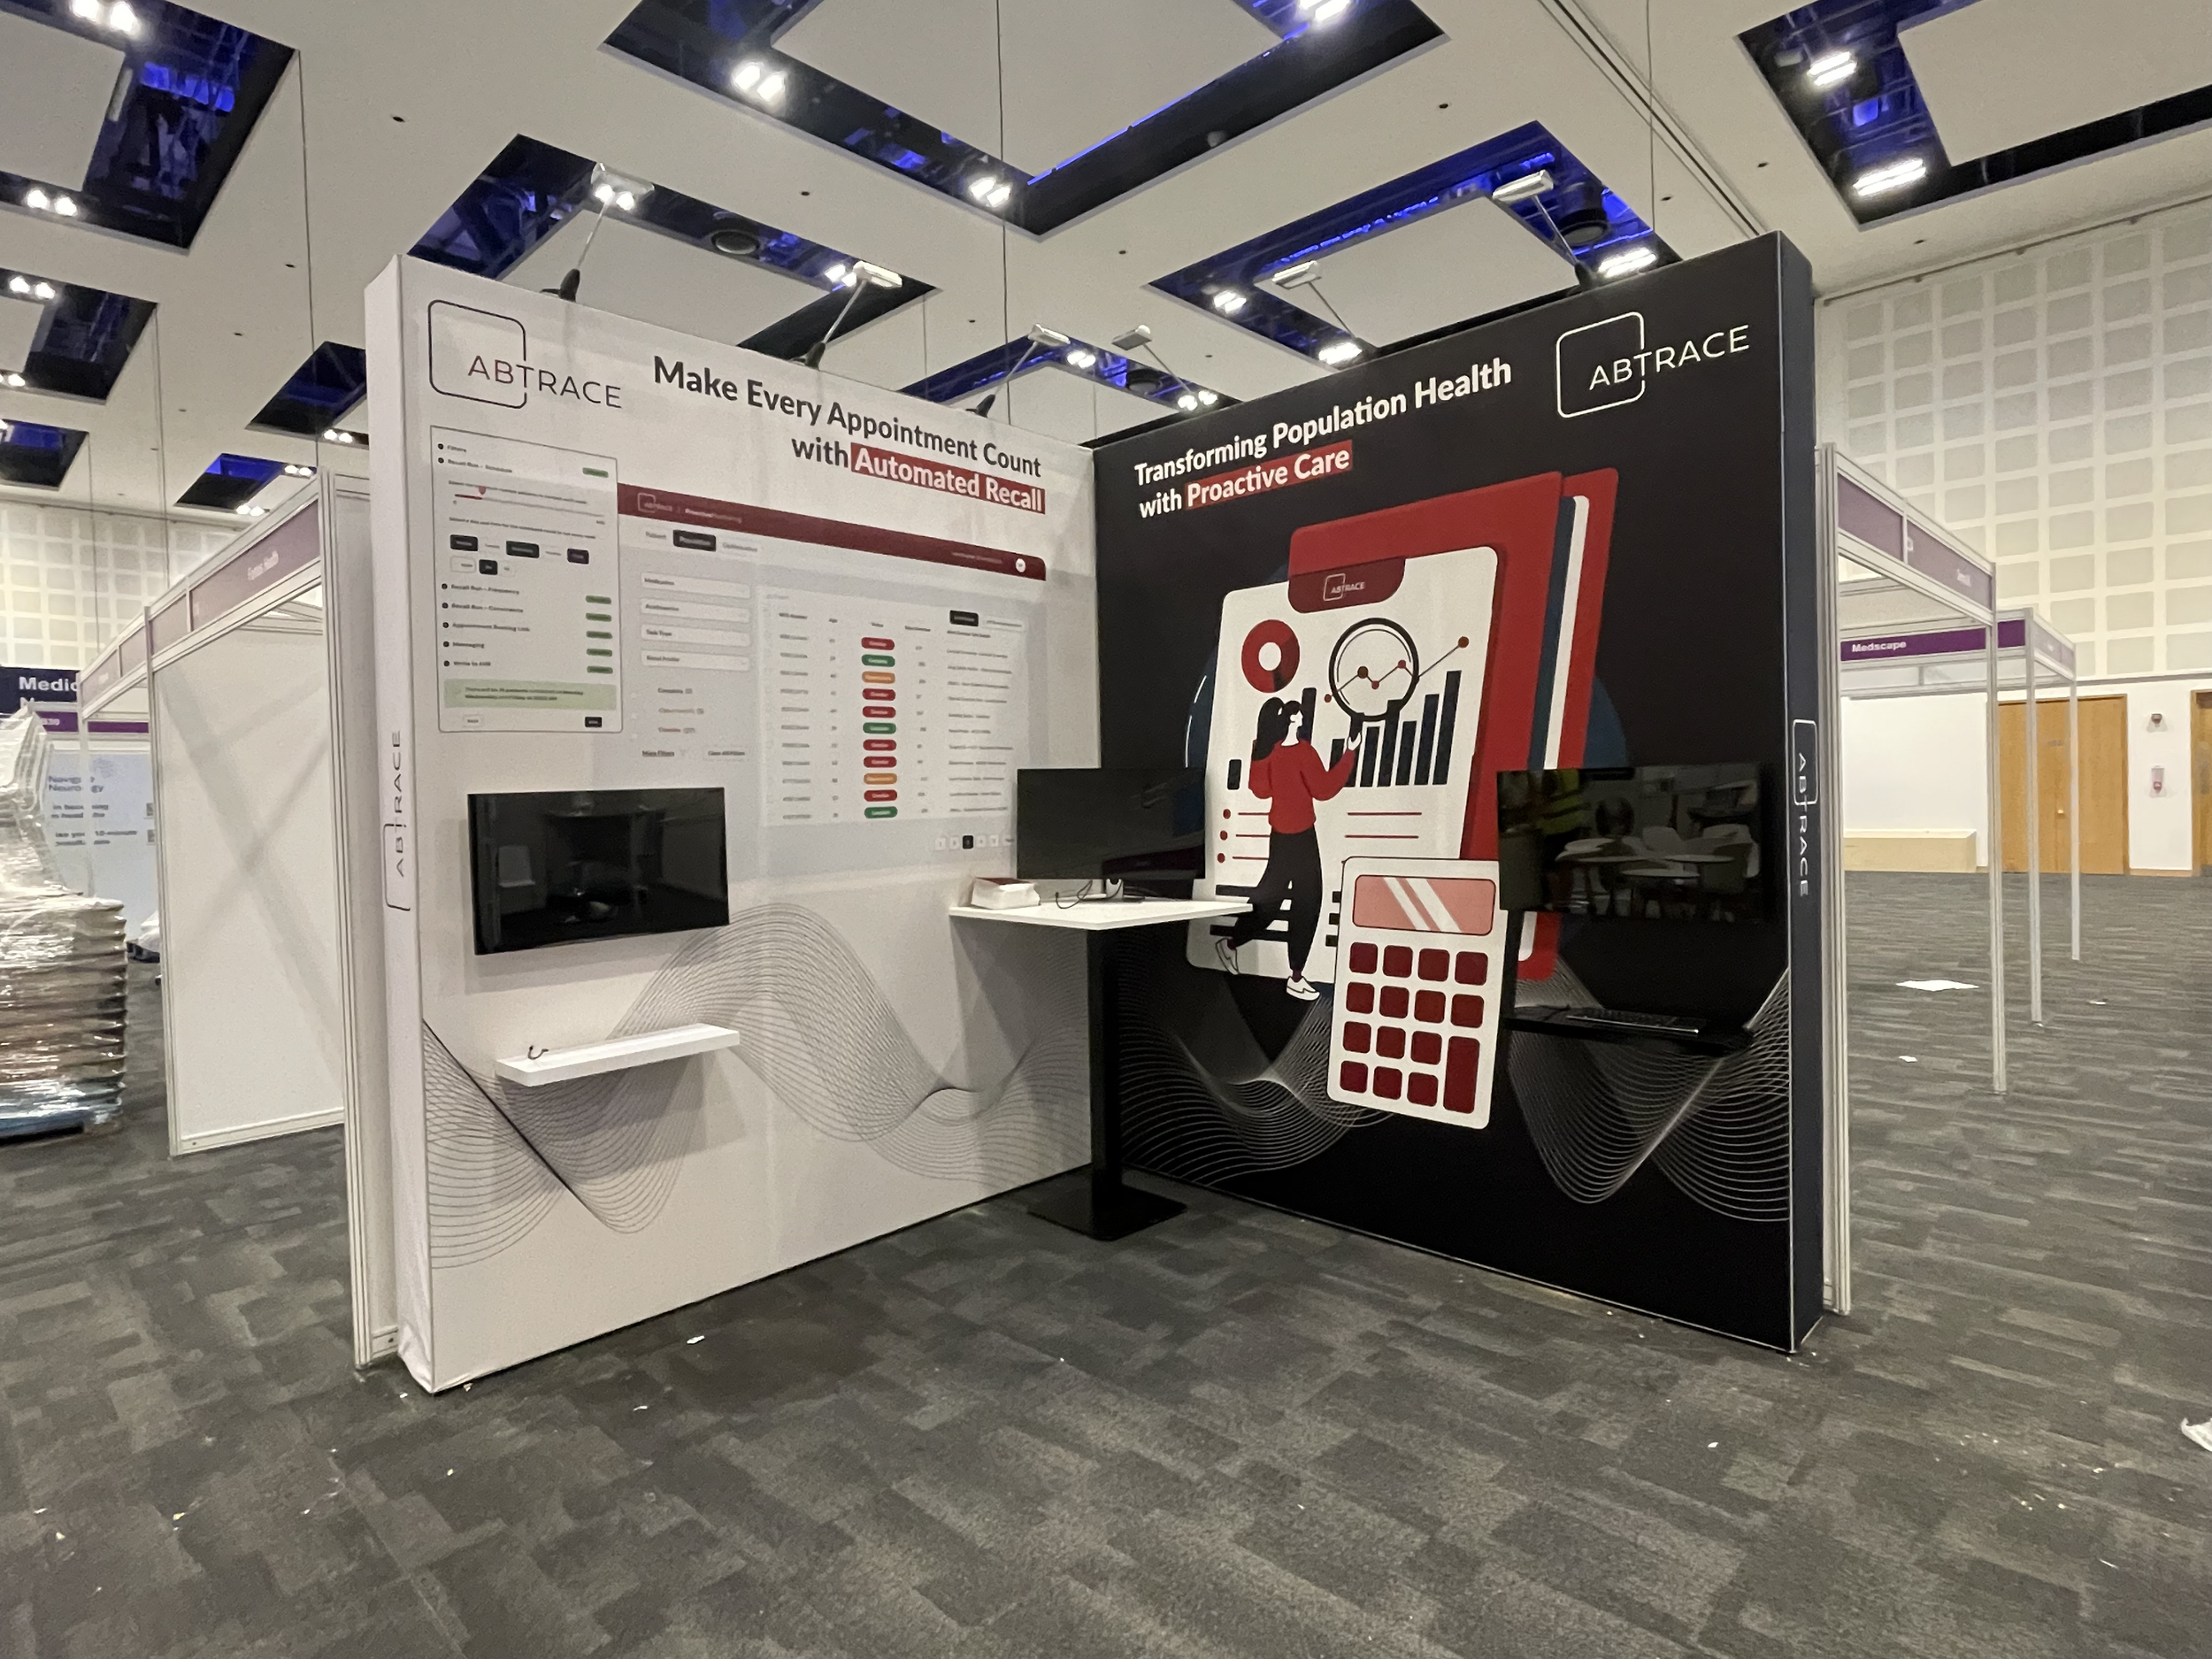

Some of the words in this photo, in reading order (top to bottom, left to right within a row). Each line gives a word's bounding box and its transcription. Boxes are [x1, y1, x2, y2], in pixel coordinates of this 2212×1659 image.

[468, 355, 623, 409] ABTRACE
[1589, 325, 1750, 391] ABTRACE
[654, 356, 738, 402] Make
[748, 380, 822, 426] Every
[827, 402, 978, 461] Appointment
[983, 443, 1042, 478] Count
[1134, 434, 1268, 487] Transforming
[1272, 393, 1408, 449] Population
[1414, 357, 1512, 409] Health
[791, 437, 849, 468] with
[855, 448, 980, 498] Automated
[986, 477, 1042, 512] Recall
[1139, 489, 1183, 519] with
[1187, 464, 1288, 508] Proactive
[1294, 449, 1350, 481] Care
[1851, 641, 1908, 653] Medscape
[391, 729, 404, 878] ABTRACE
[1799, 752, 1809, 897] ABTRACE
